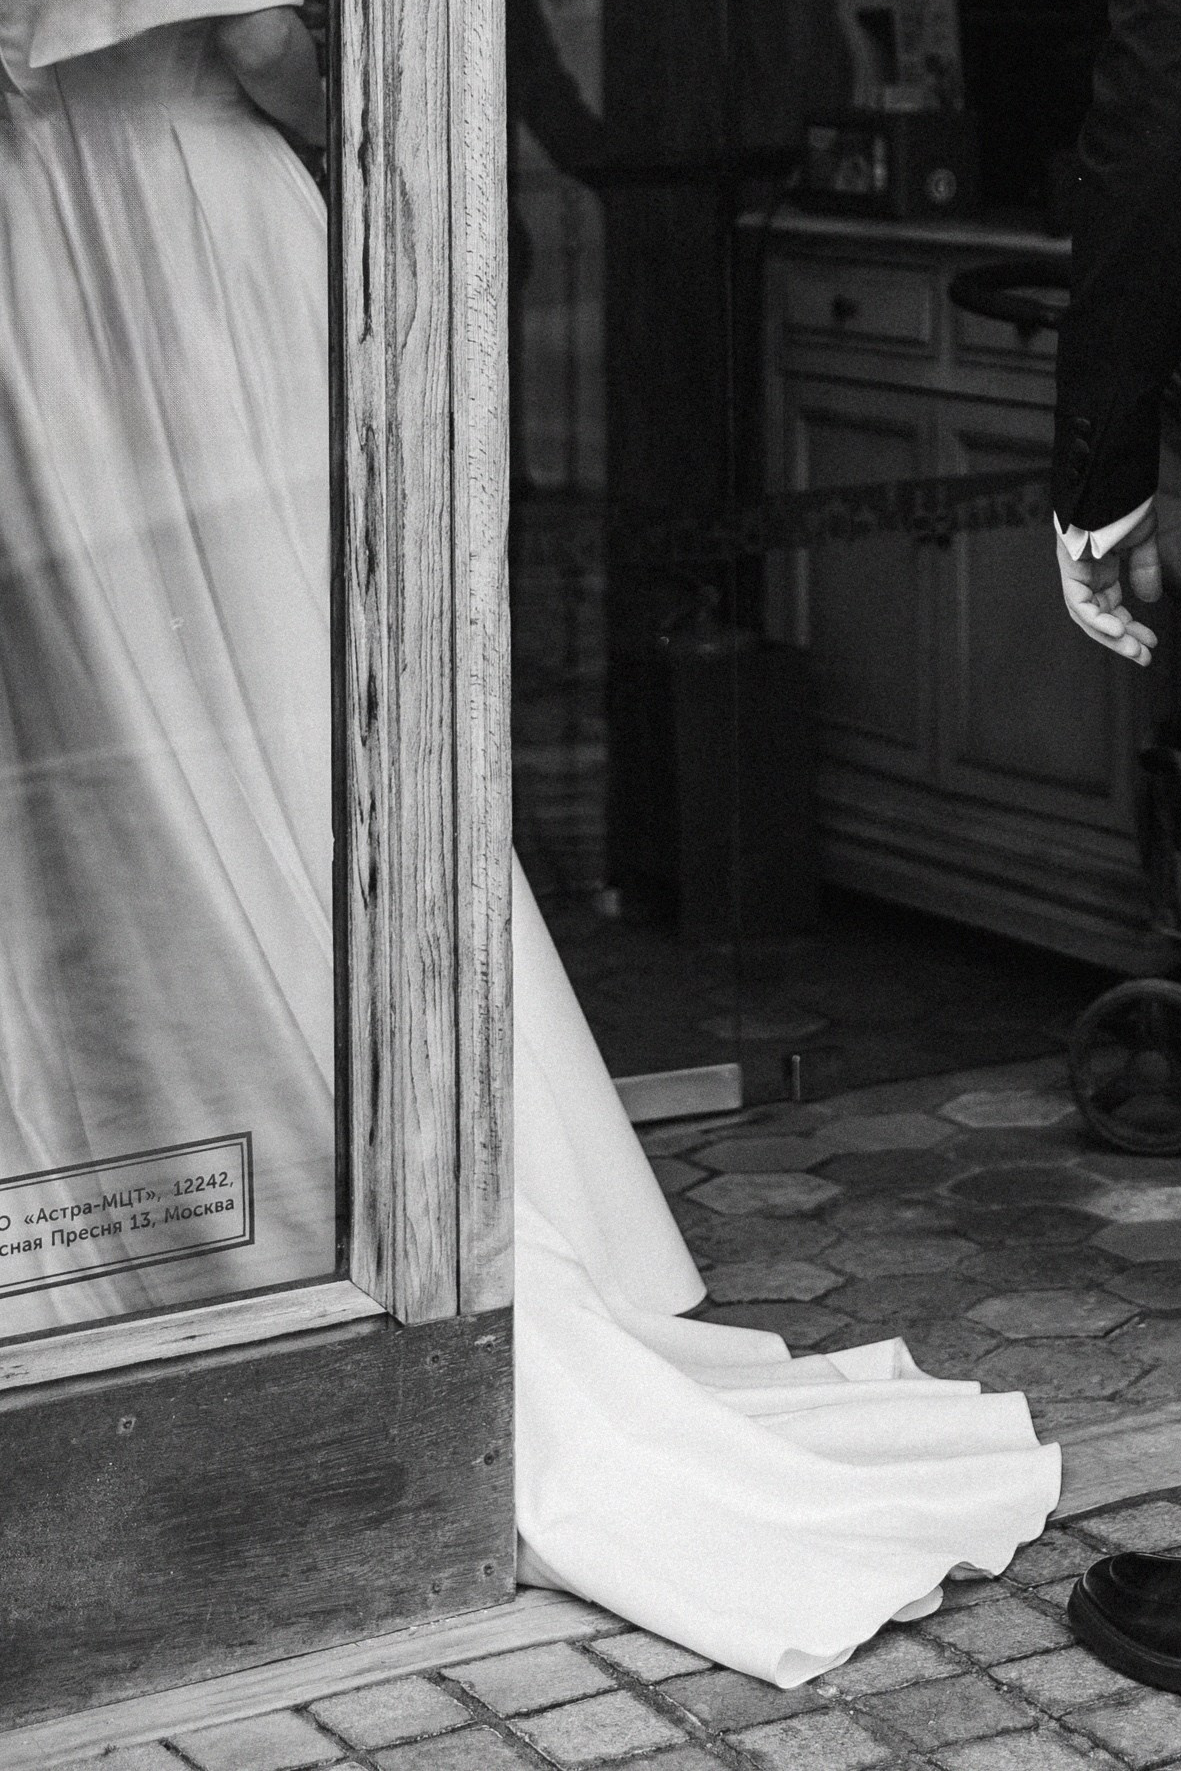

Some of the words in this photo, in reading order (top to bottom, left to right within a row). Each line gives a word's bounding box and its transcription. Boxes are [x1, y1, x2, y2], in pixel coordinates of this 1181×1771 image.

[24, 1187, 162, 1225] «Астра-МЦТ»,
[173, 1171, 234, 1197] 12242,
[51, 1221, 122, 1247] Пресня
[129, 1212, 156, 1231] 13,
[164, 1199, 235, 1224] Москва
